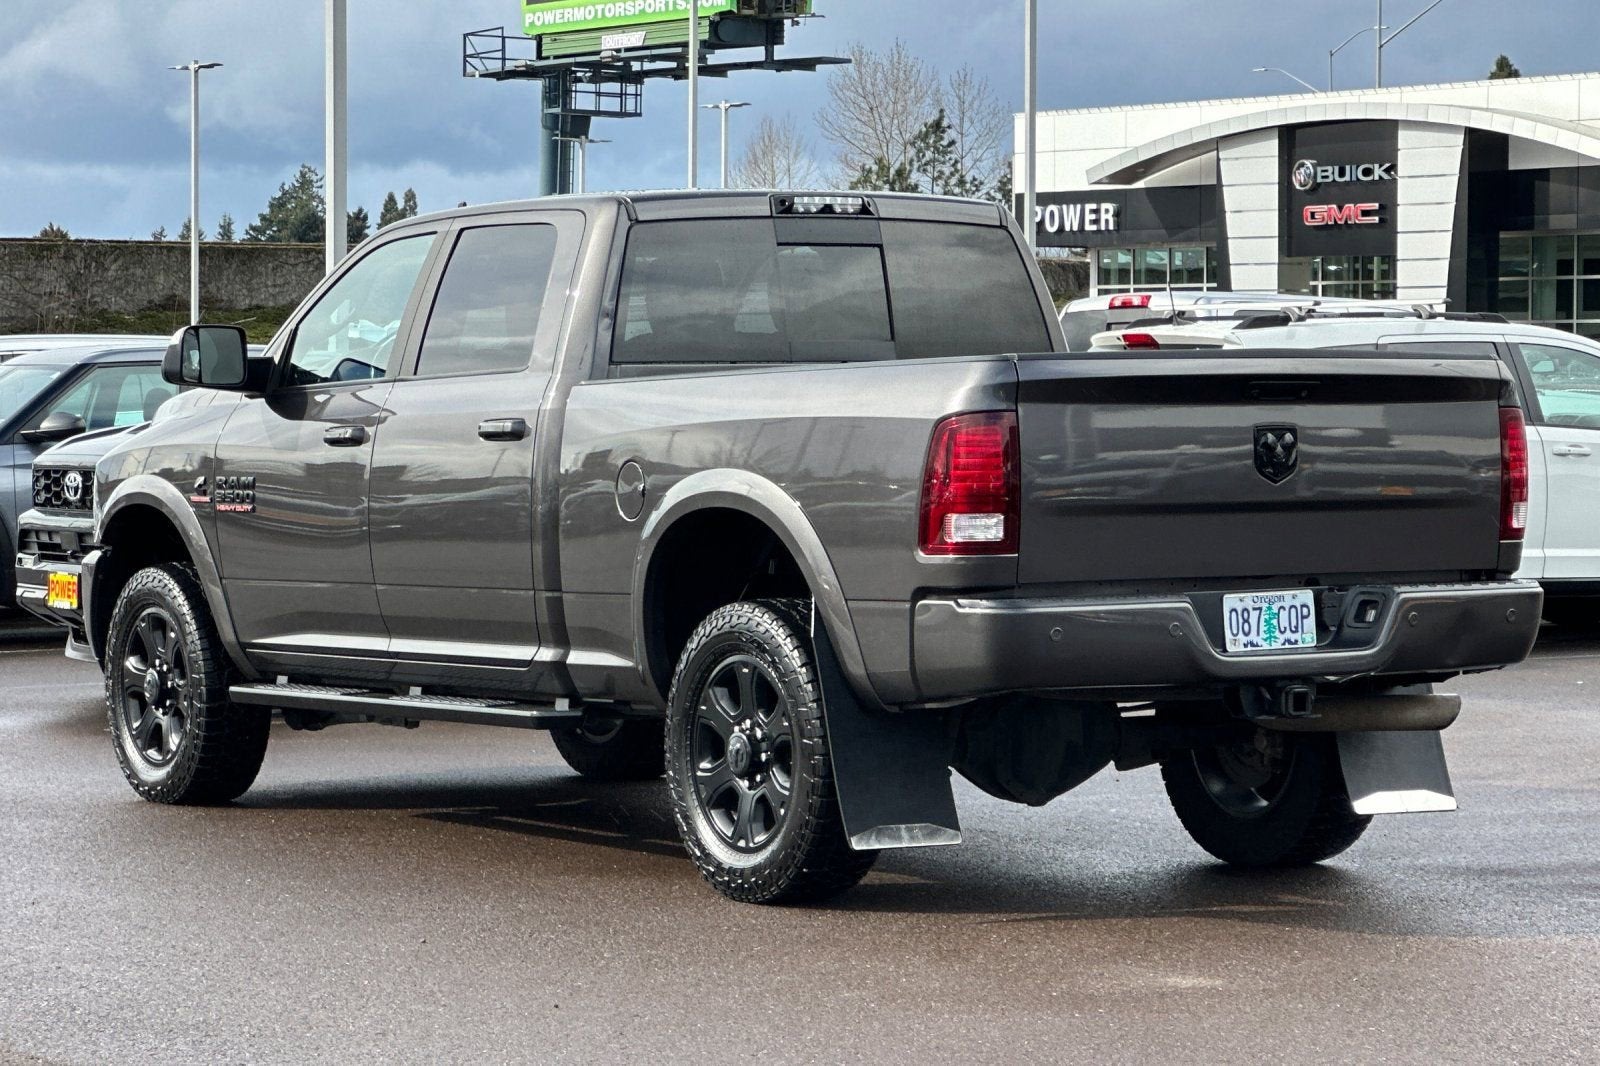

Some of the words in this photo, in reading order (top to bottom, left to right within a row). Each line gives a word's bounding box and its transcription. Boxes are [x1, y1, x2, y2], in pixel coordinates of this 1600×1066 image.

[525, 0, 726, 27] POWERMOTORSPORTS.O
[1316, 163, 1392, 183] BUICK
[1303, 202, 1379, 226] GMC
[215, 476, 256, 489] RAM
[235, 504, 253, 512] DUTY
[50, 580, 77, 599] POWER
[1252, 594, 1285, 606] Oregon
[1229, 607, 1262, 637] 087
[1277, 604, 1311, 635] CQP
